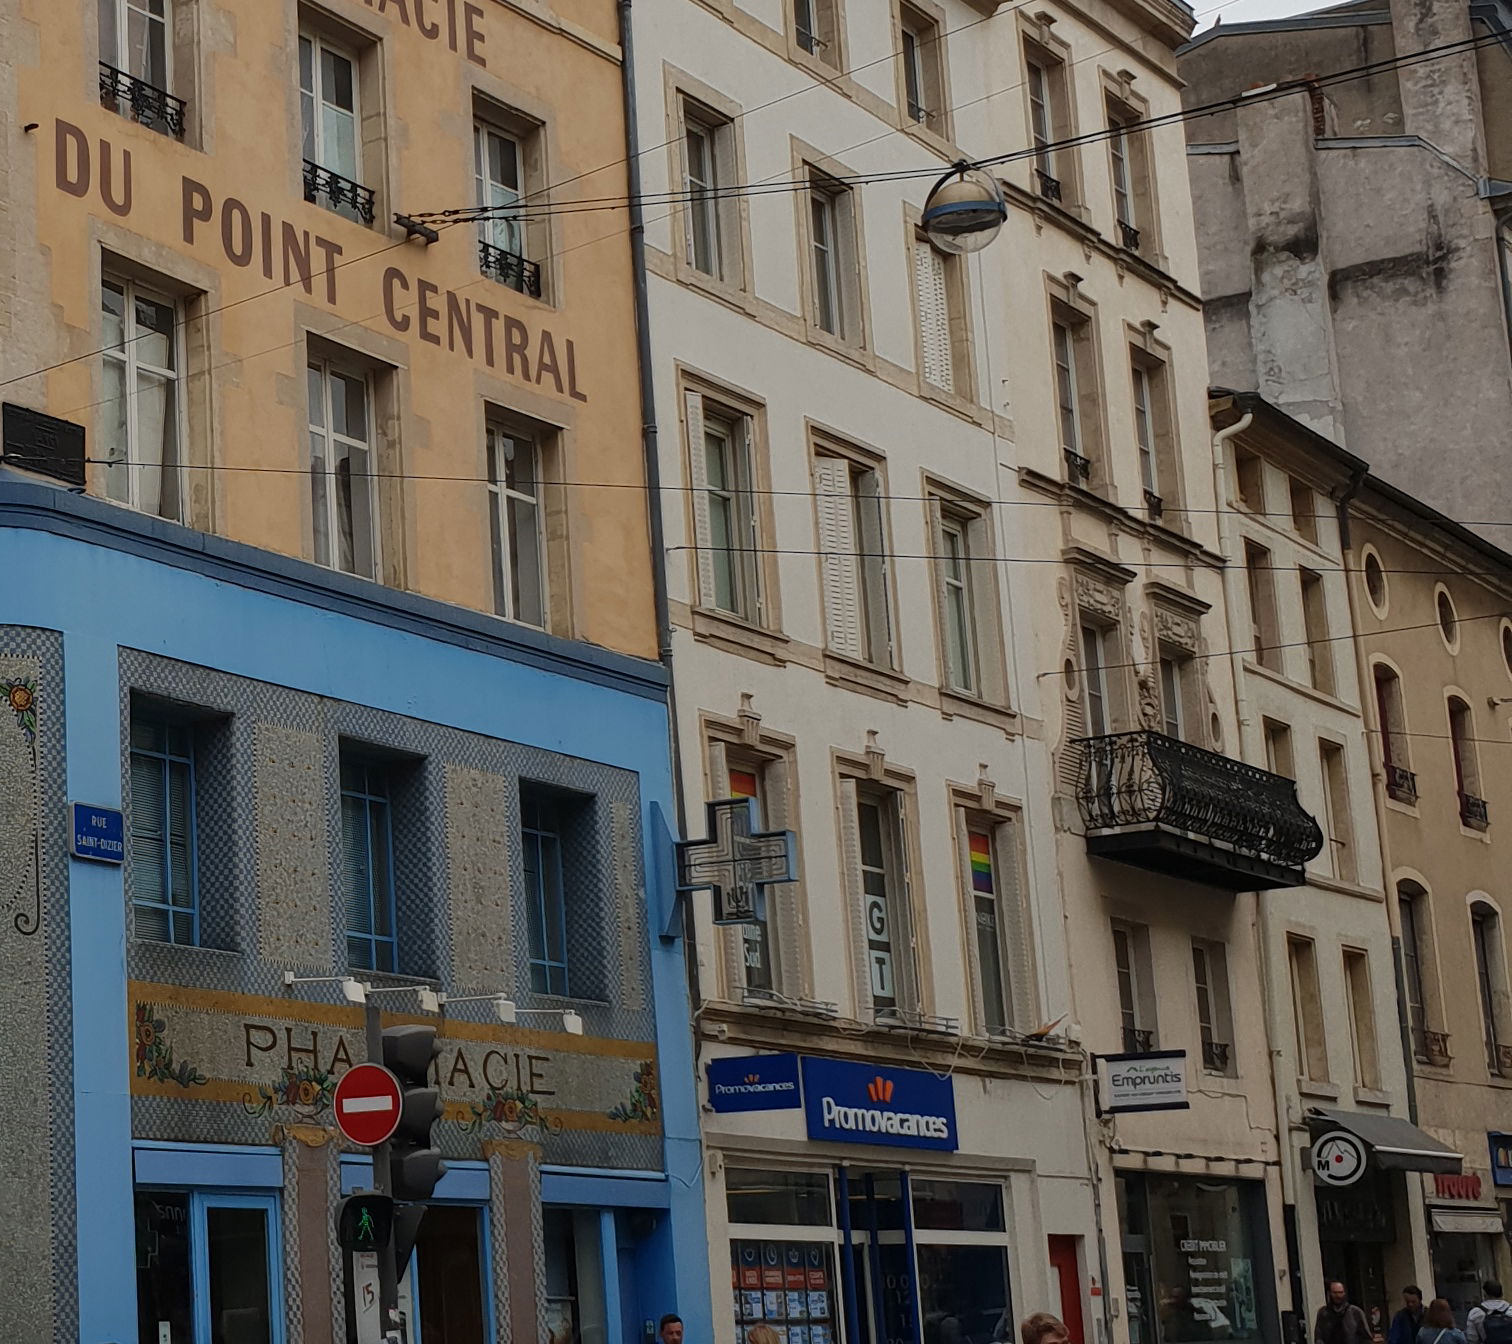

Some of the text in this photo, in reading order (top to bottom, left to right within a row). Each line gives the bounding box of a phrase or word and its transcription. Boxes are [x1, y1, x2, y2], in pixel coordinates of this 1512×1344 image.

[54, 117, 589, 402] DU POINT CENTRAL
[91, 815, 107, 828] RUE
[77, 834, 123, 853] SAINT-DIZIER
[869, 900, 885, 936] G
[242, 1022, 556, 1096] PHAACIE
[714, 1072, 795, 1094] Promovacances
[1111, 1071, 1182, 1090] Empruntis
[821, 1094, 949, 1140] Promovacances
[1317, 1160, 1330, 1171] M
